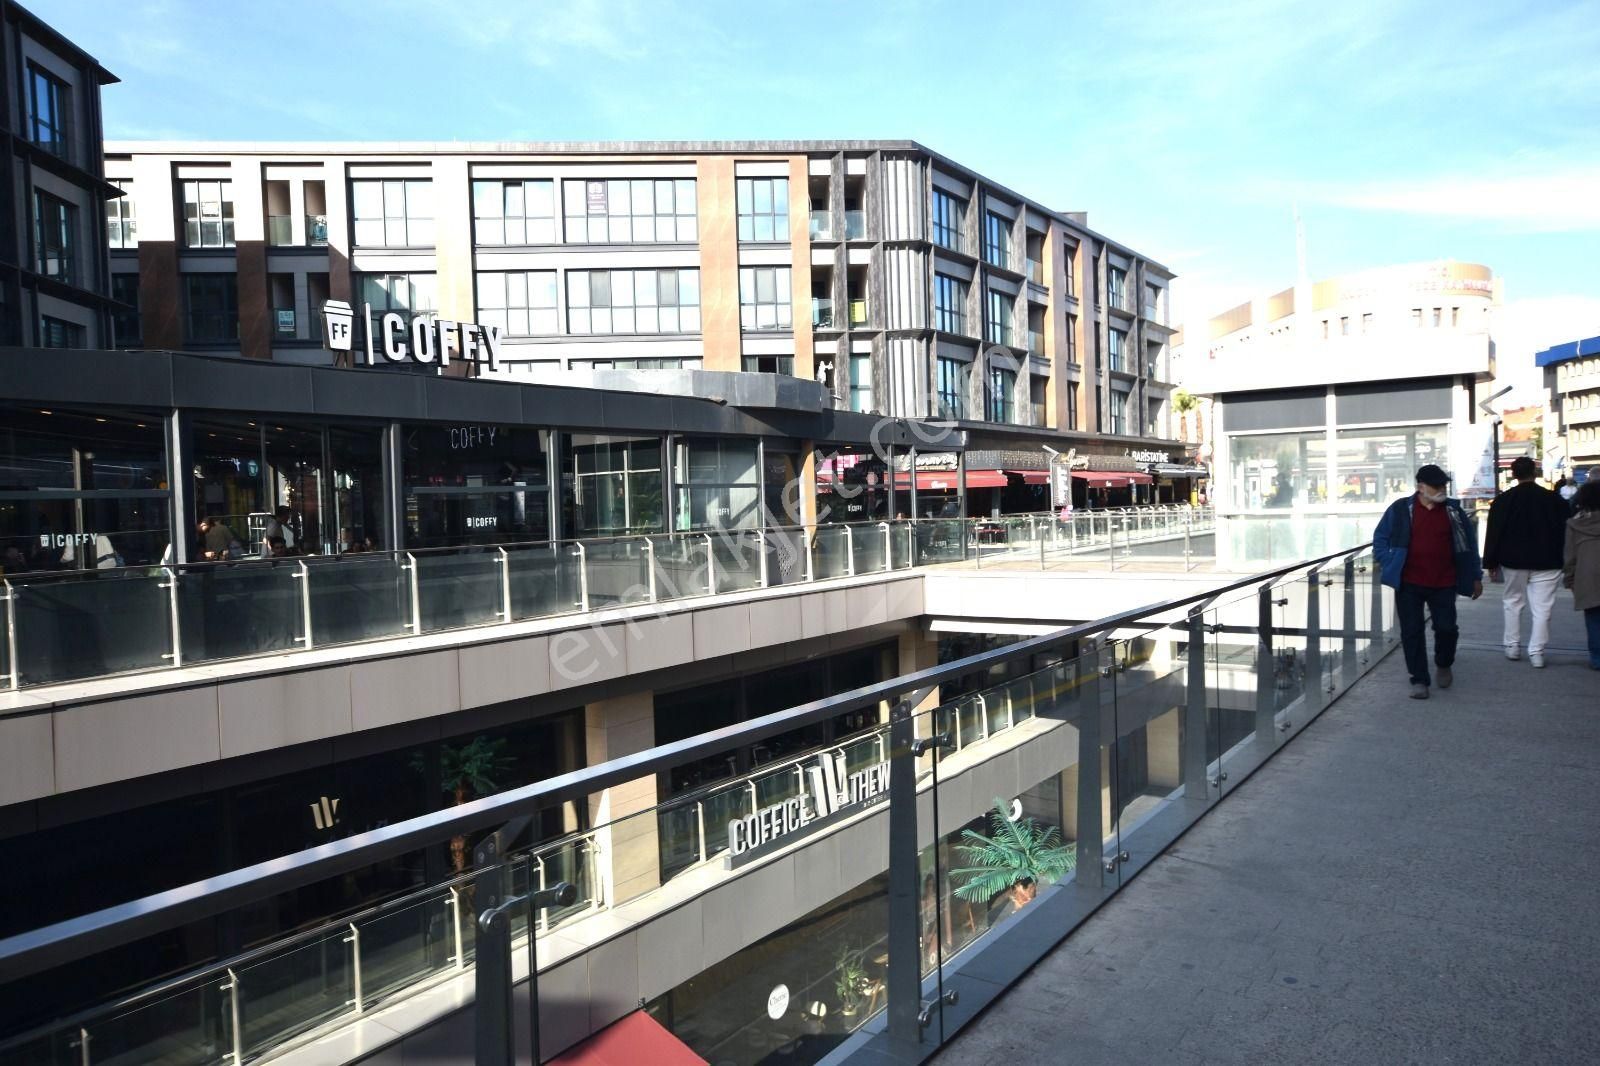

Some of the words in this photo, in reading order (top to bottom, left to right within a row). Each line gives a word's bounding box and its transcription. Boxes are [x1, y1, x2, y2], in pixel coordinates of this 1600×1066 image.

[332, 322, 348, 341] FF
[383, 312, 502, 372] COFFY
[451, 426, 496, 449] COFFY
[476, 516, 497, 527] COFFY
[57, 533, 98, 547] COFFY
[728, 793, 816, 856] COFFICE
